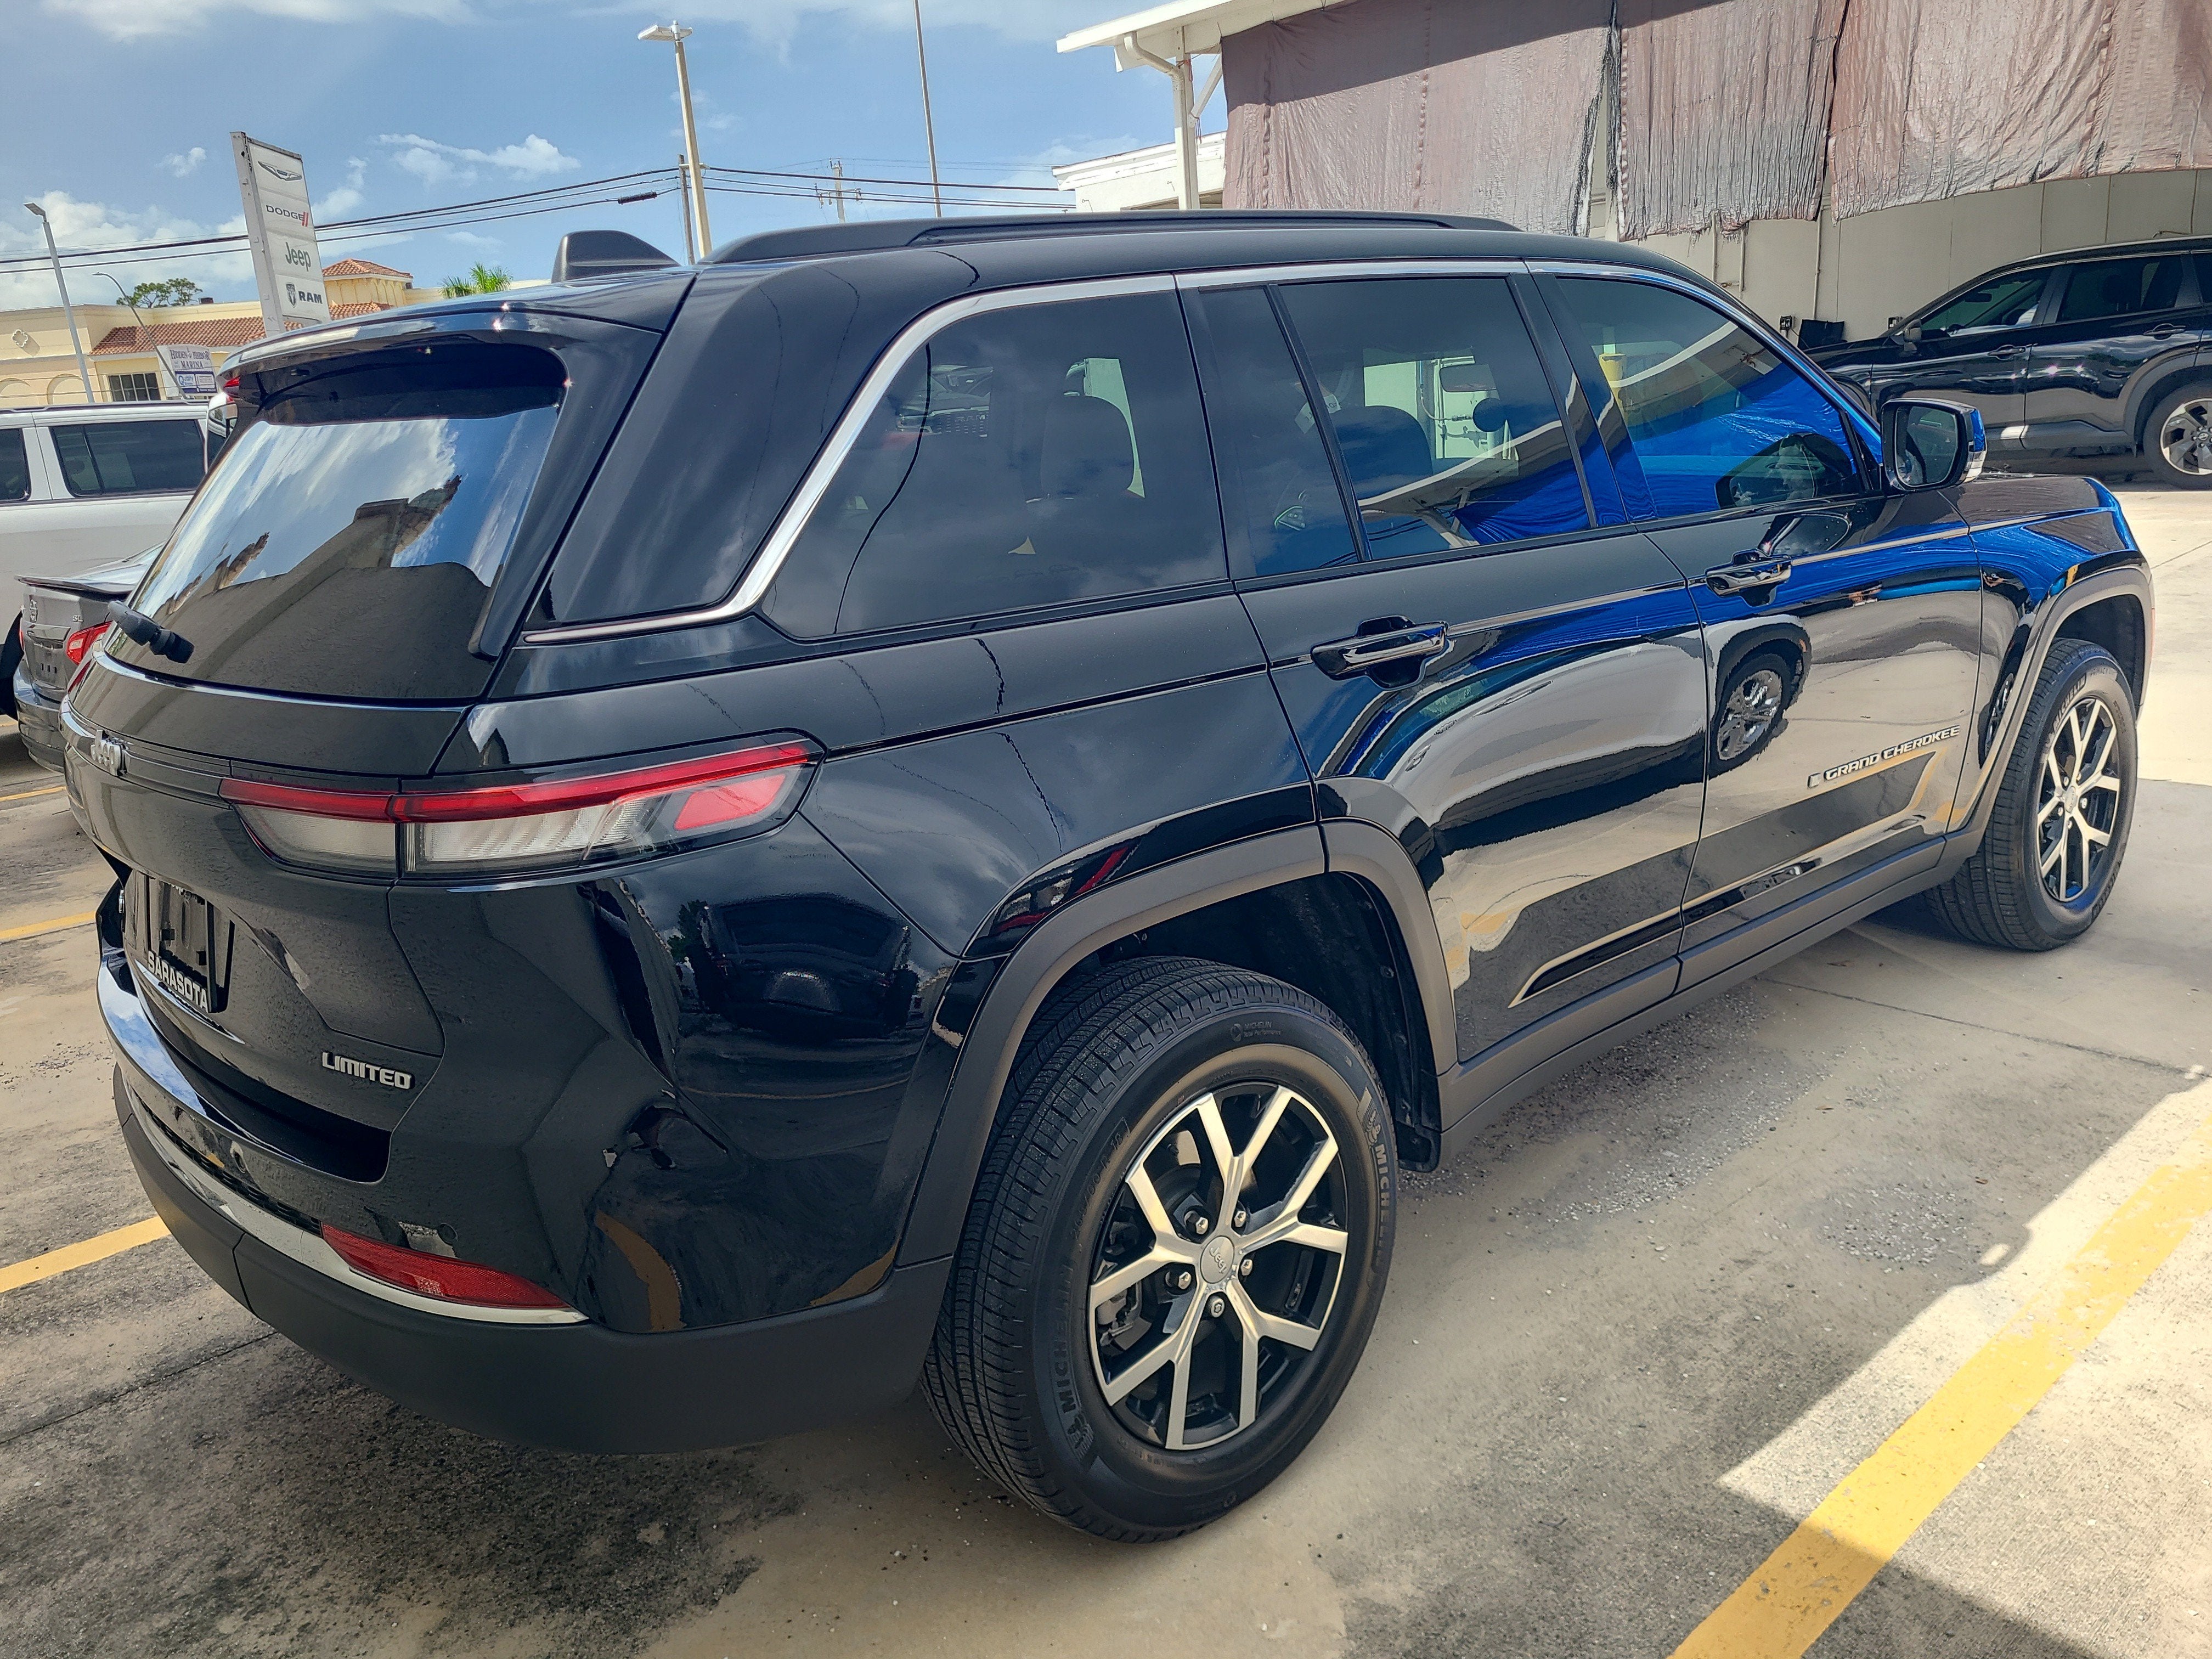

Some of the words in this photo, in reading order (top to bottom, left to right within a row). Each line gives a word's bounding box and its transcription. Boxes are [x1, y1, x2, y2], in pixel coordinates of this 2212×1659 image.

[266, 205, 304, 221] DODGE
[285, 241, 311, 272] Jeep
[298, 290, 323, 304] RAM
[180, 360, 204, 369] MARINA
[91, 729, 121, 776] Jeep
[1824, 753, 1881, 781] GRAND
[1881, 724, 1961, 760] CHEROKEE
[148, 950, 209, 1013] SARASOTA
[322, 1052, 412, 1090] LIMITED
[1210, 1246, 1227, 1274] Jeep
